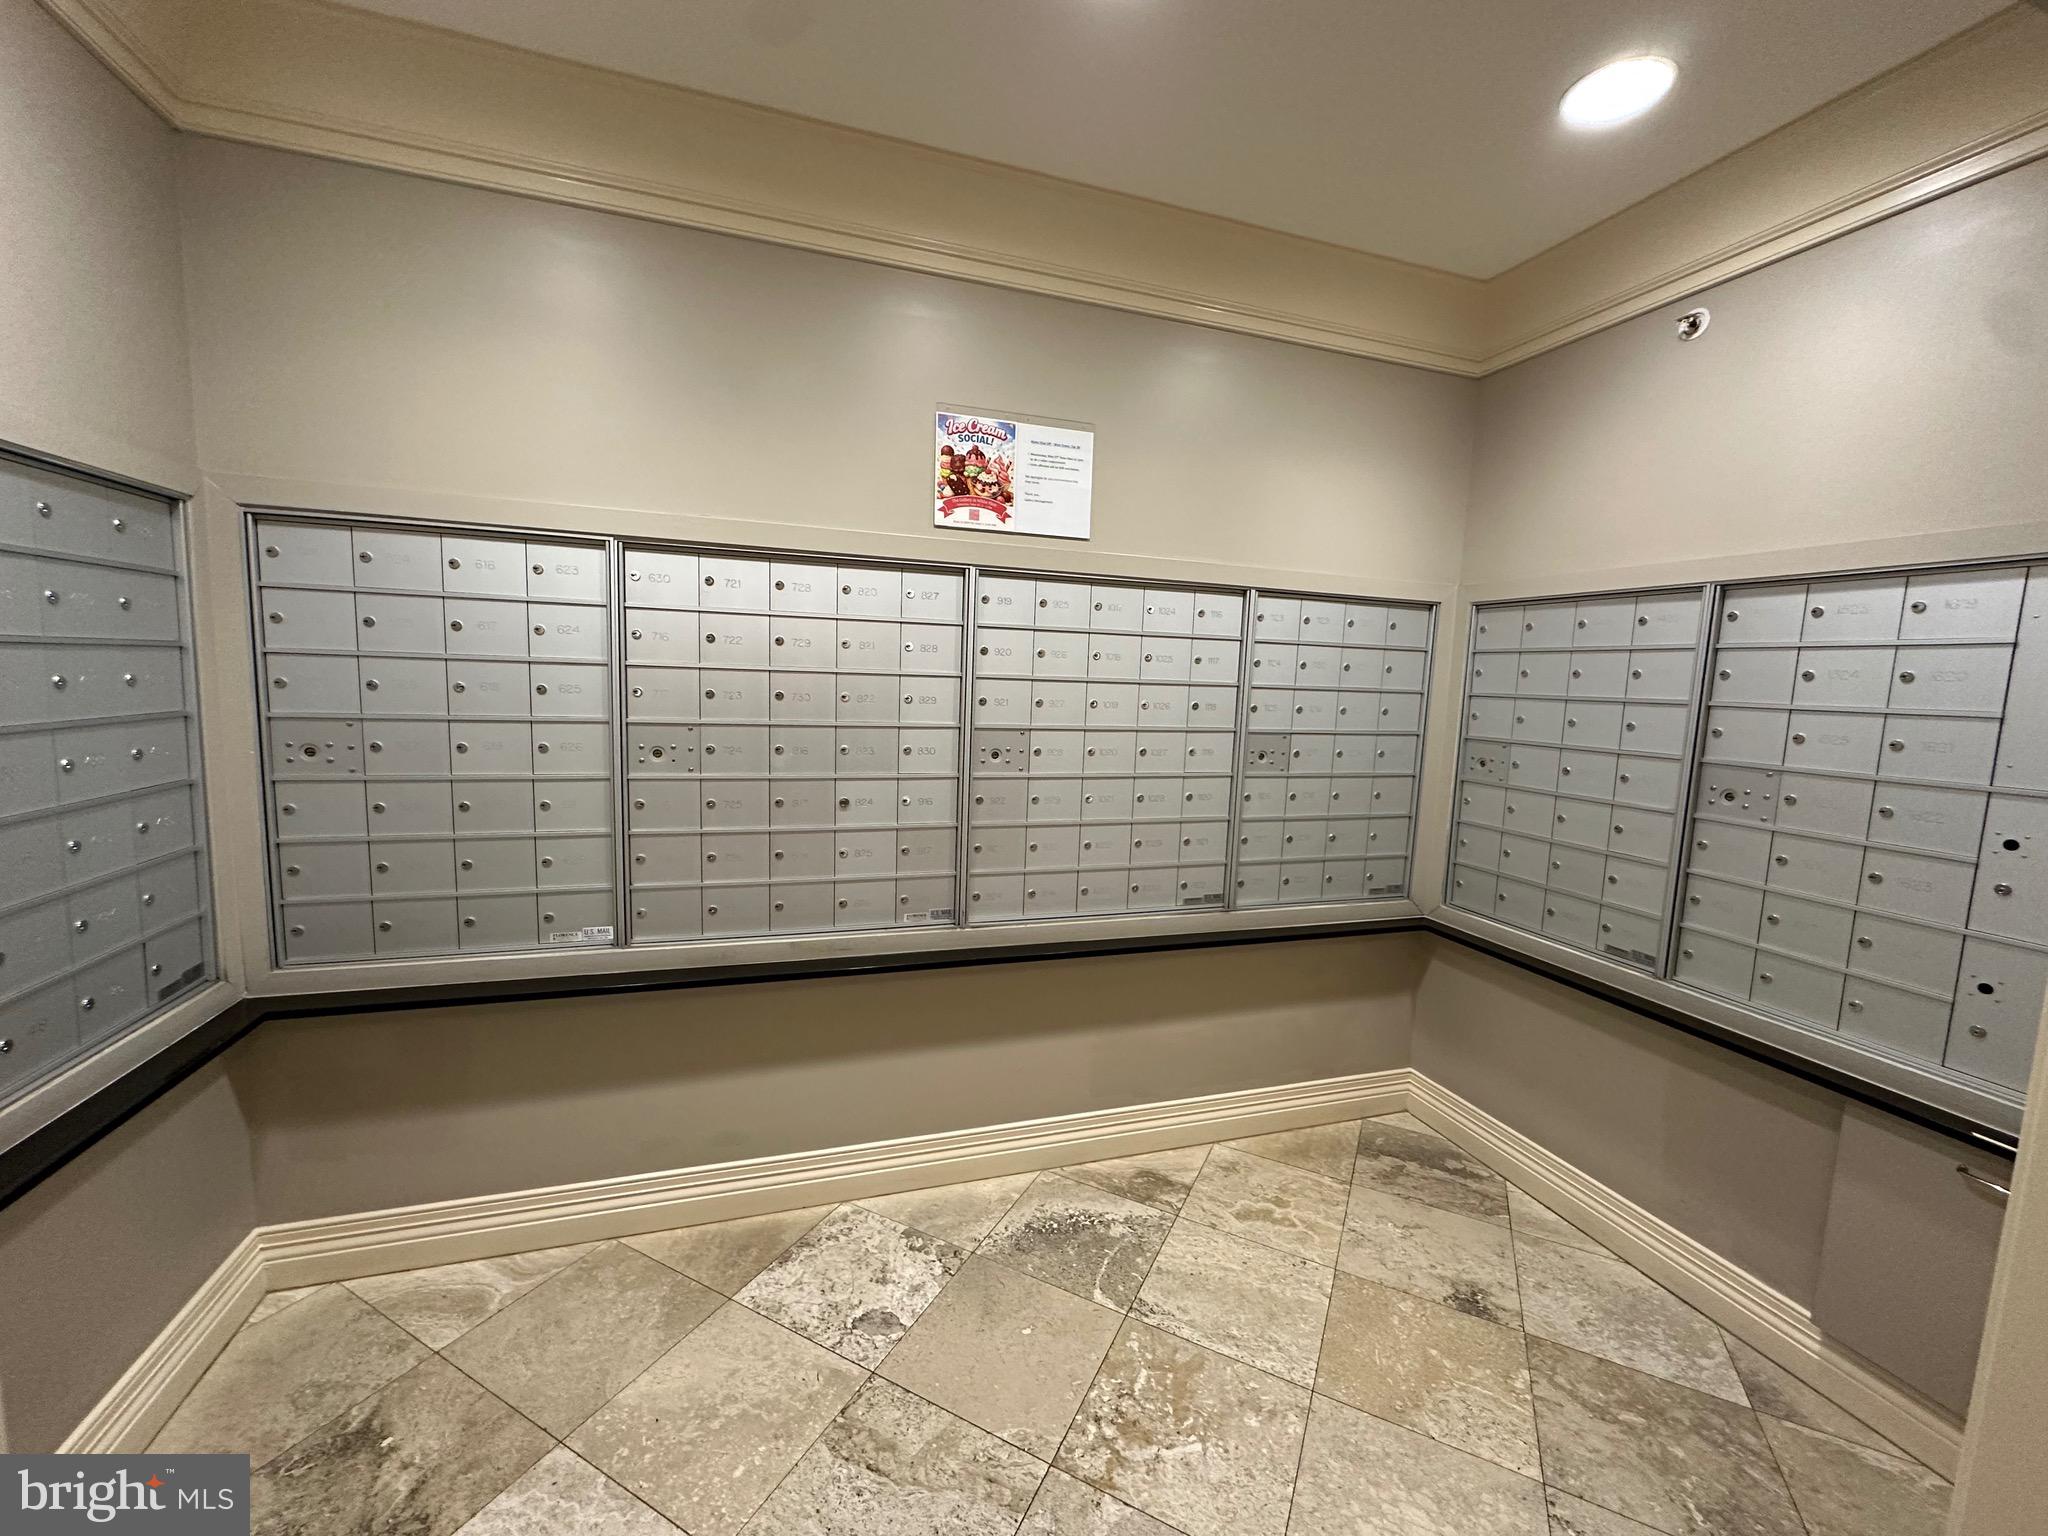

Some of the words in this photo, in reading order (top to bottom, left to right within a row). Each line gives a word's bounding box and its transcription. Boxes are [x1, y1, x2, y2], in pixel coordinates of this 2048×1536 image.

[945, 418, 966, 436] Ice
[967, 418, 1008, 442] Cream
[957, 433, 995, 446] SOCIAL!
[474, 559, 496, 571] 616
[555, 563, 580, 576] 623
[647, 573, 672, 584] 630
[723, 578, 742, 589] 721
[791, 582, 812, 593] 728
[857, 586, 878, 597] 820
[920, 590, 939, 601] 827
[996, 596, 1013, 606] 919
[556, 624, 581, 635] 624
[722, 635, 743, 646] 722
[791, 637, 812, 648] 729
[919, 643, 939, 654] 828
[993, 647, 1012, 657] 920
[558, 683, 582, 695] 625
[722, 689, 743, 700] 723
[918, 695, 937, 705] 829
[993, 698, 1009, 707] 921
[559, 742, 583, 753] 626
[916, 745, 936, 756] 830
[854, 797, 874, 807] 824
